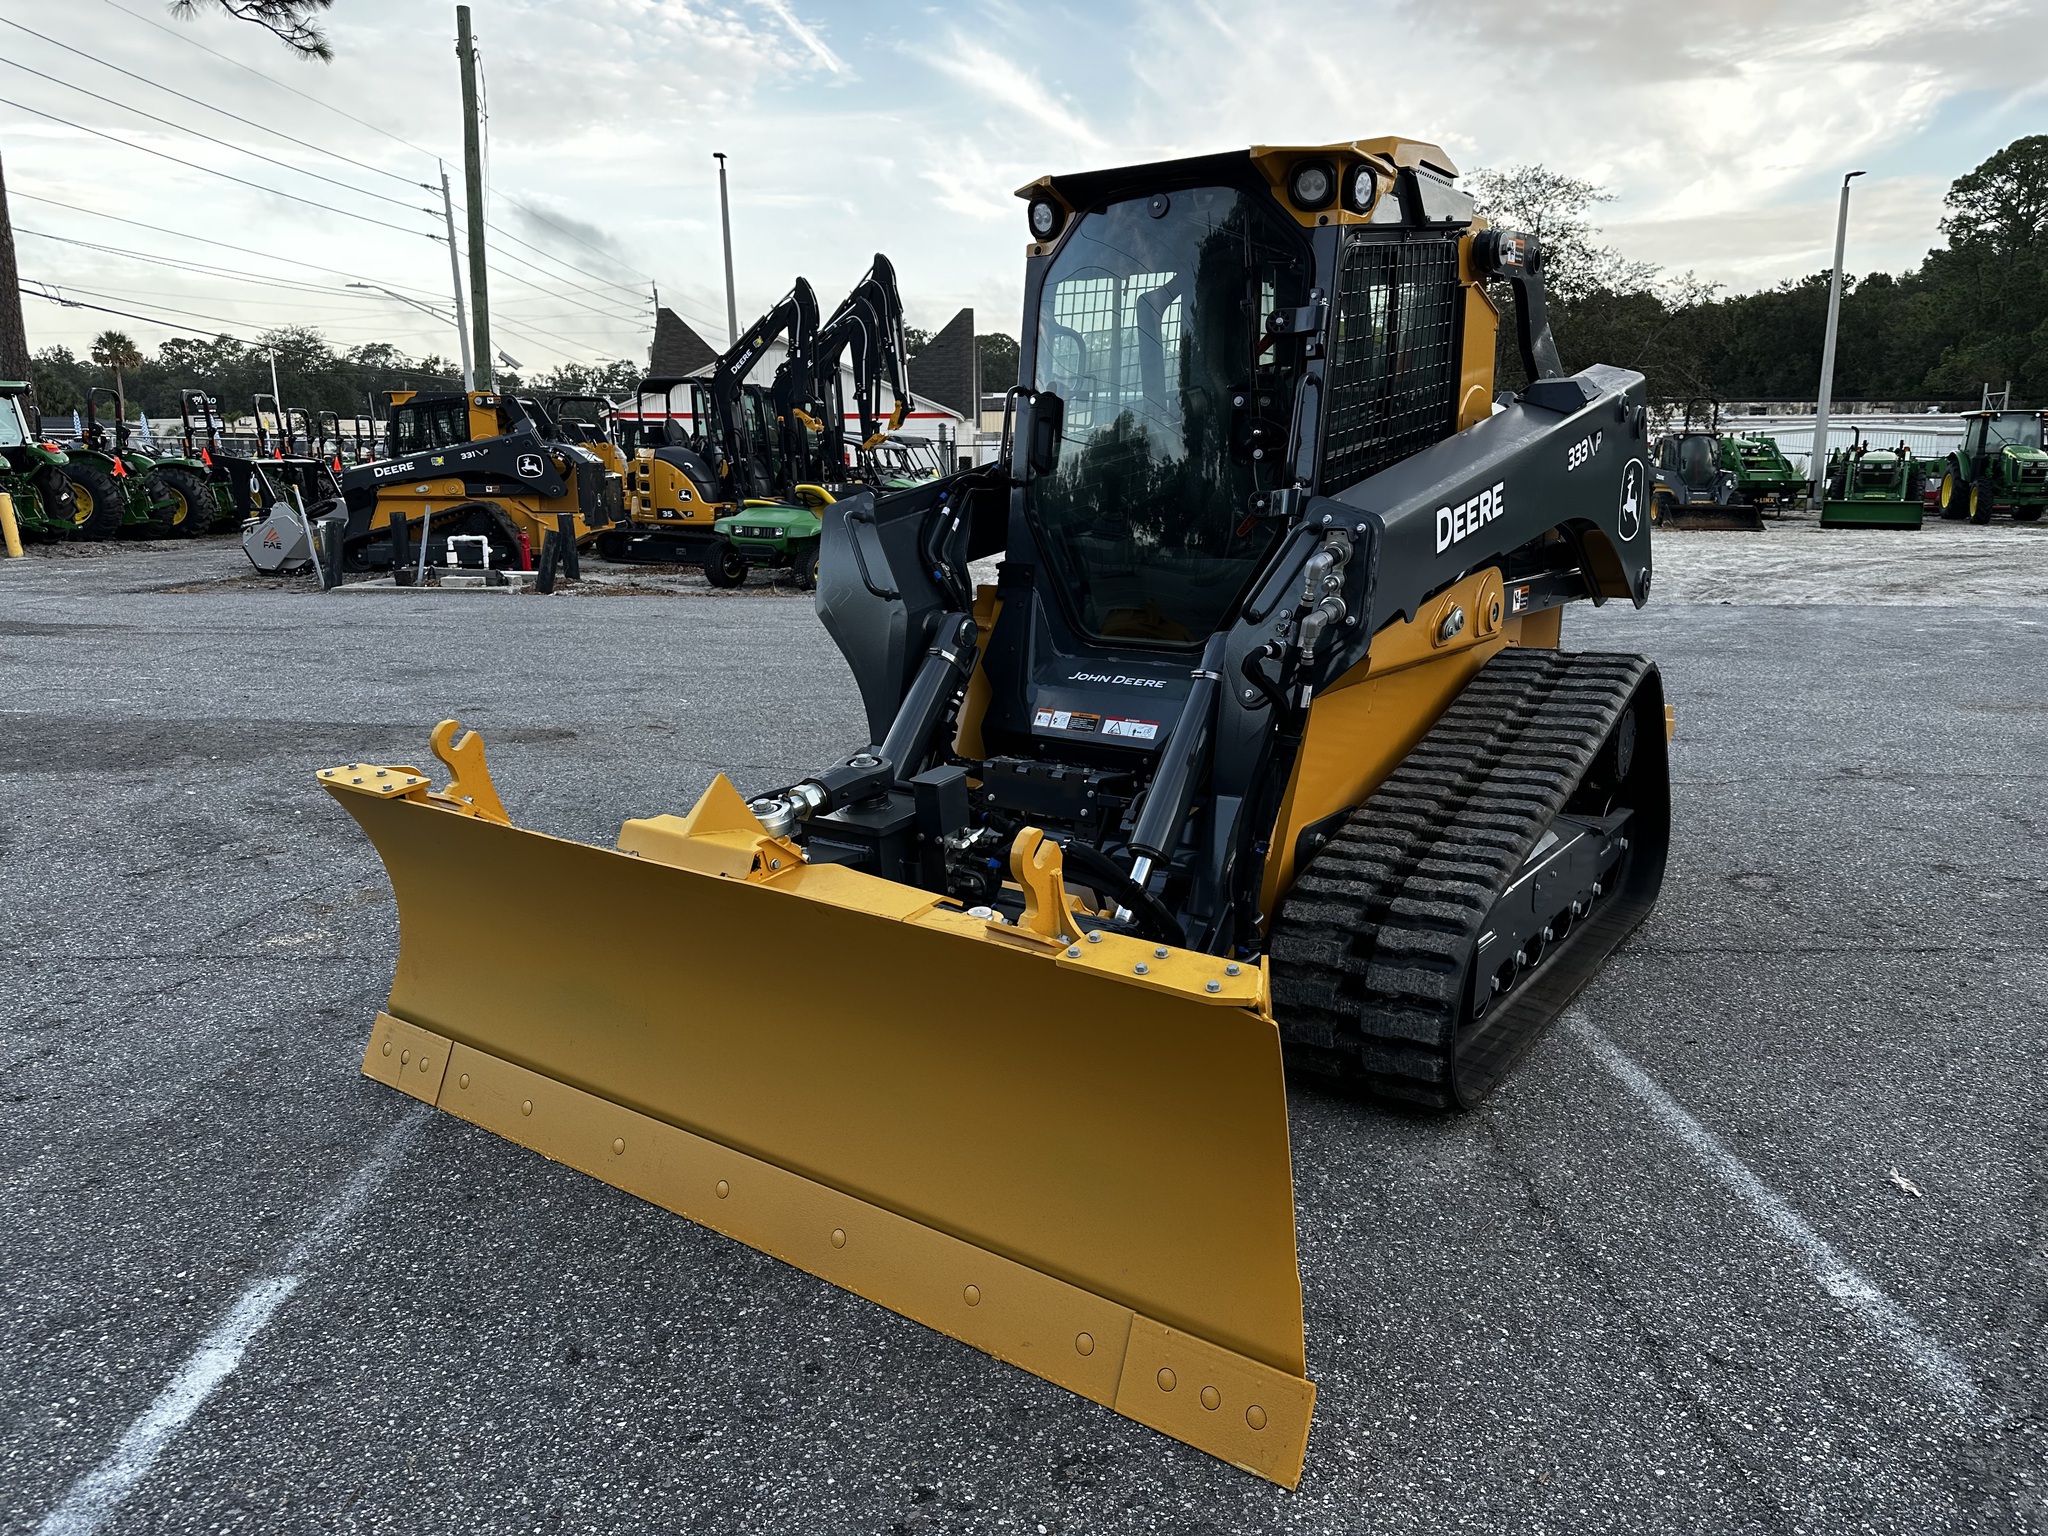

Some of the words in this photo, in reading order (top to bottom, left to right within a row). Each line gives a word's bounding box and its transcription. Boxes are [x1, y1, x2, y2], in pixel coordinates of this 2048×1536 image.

[730, 349, 753, 374] DEERE
[373, 462, 415, 478] DEERE
[662, 510, 673, 518] 35
[1436, 481, 1504, 554] DEERE
[263, 541, 282, 550] FAE
[1068, 672, 1111, 683] JOHN
[1112, 675, 1167, 688] DEERE
